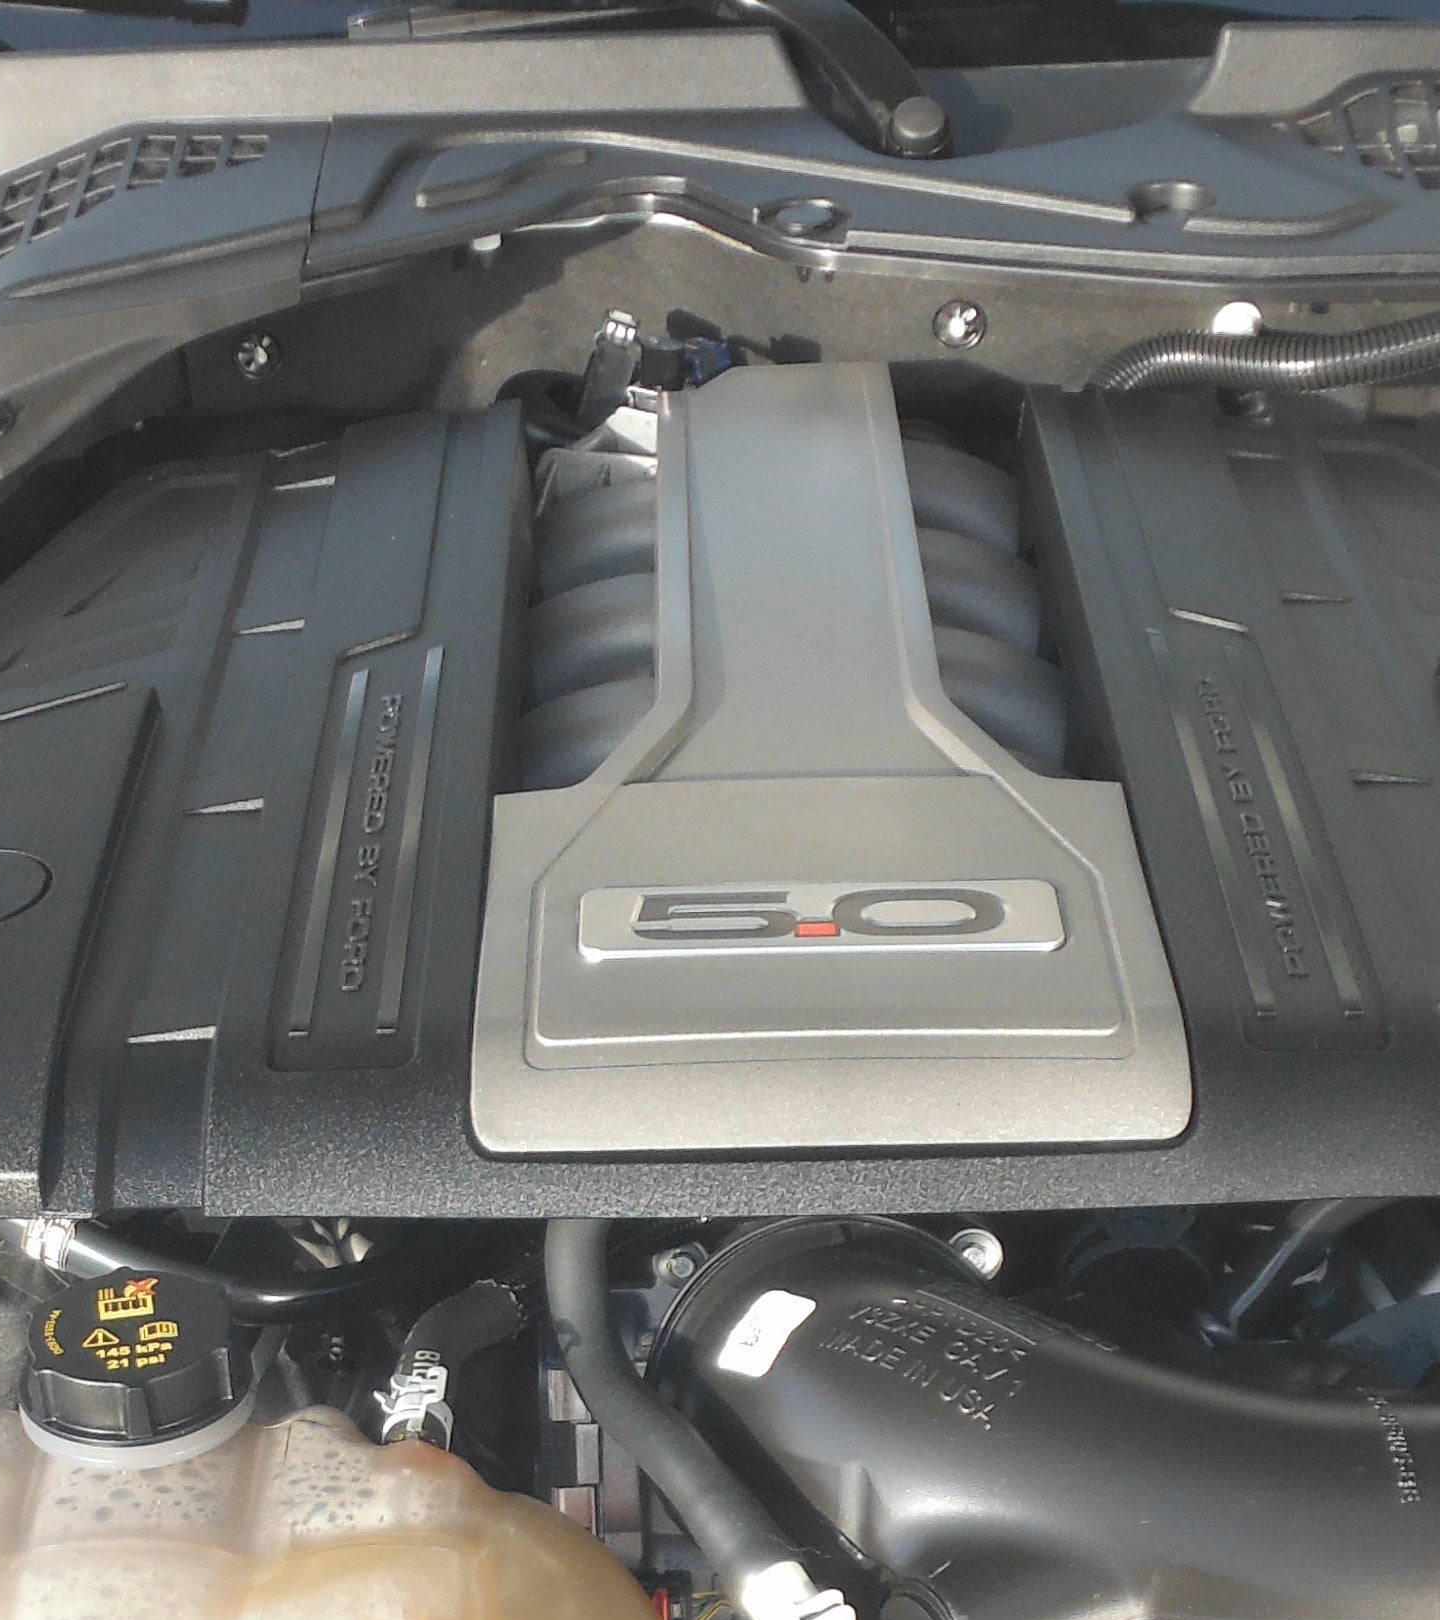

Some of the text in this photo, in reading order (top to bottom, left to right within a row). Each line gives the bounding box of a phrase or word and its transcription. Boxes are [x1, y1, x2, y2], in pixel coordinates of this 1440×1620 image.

[1223, 765, 1255, 804] BY
[339, 693, 404, 992] POWERED BY FORD
[629, 887, 1006, 940] 5.0
[1240, 812, 1310, 980] POWERED
[95, 1341, 174, 1359] 145 kPa
[107, 1354, 166, 1370] 21 psi
[818, 1327, 908, 1371] MADE
[903, 1360, 941, 1389] IN
